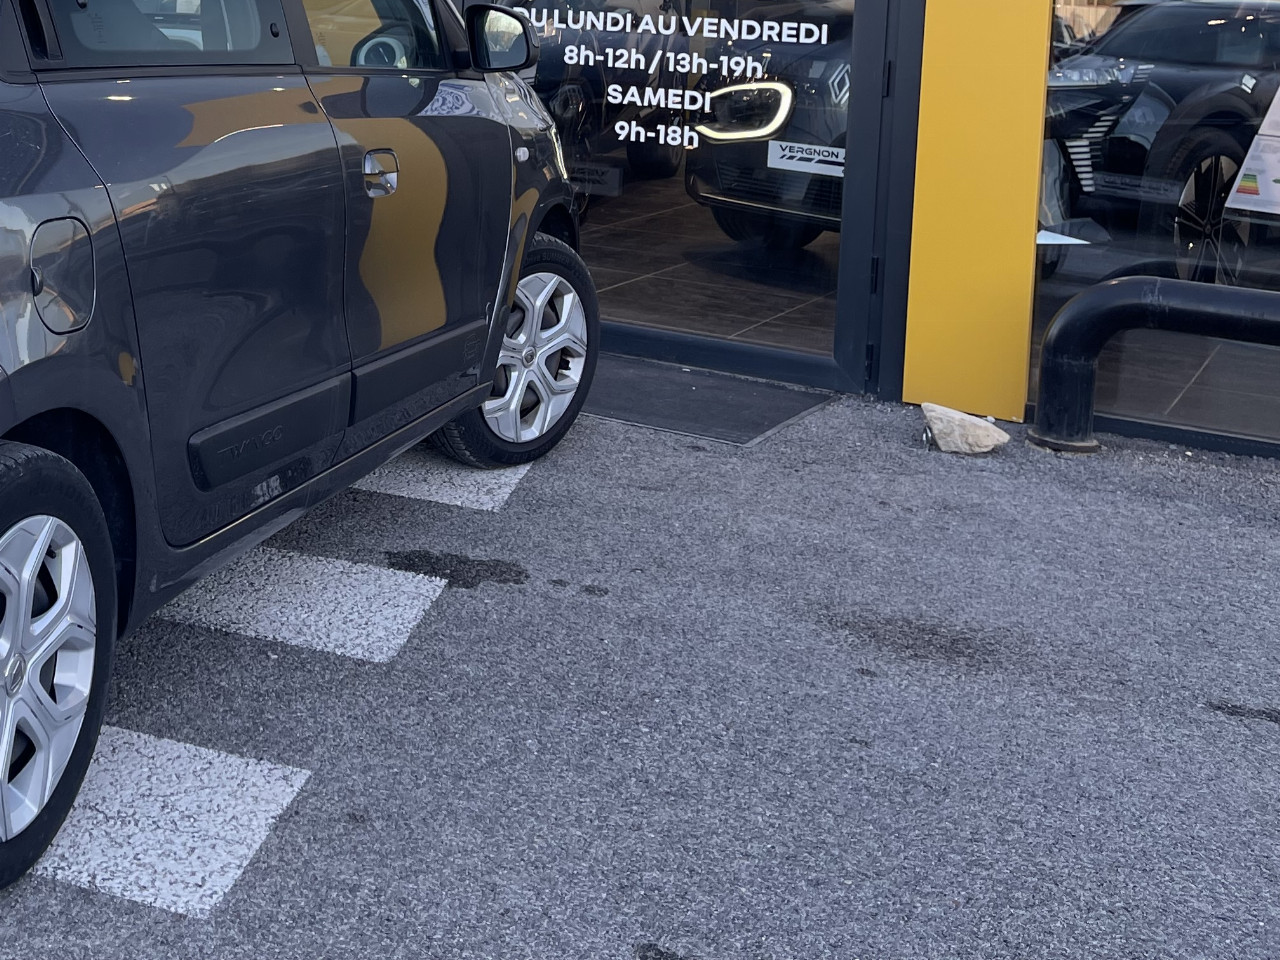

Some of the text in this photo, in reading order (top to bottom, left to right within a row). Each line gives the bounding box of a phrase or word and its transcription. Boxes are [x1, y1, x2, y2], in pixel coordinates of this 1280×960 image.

[553, 8, 632, 33] LUNDI
[636, 12, 677, 35] AU
[681, 16, 829, 45] VENDREDI
[563, 45, 646, 71] 8h-12h
[666, 51, 763, 79] 13h-19h
[606, 83, 712, 113] SAMEDI
[613, 120, 700, 148] 9h-18h
[778, 143, 840, 160] VERGNON
